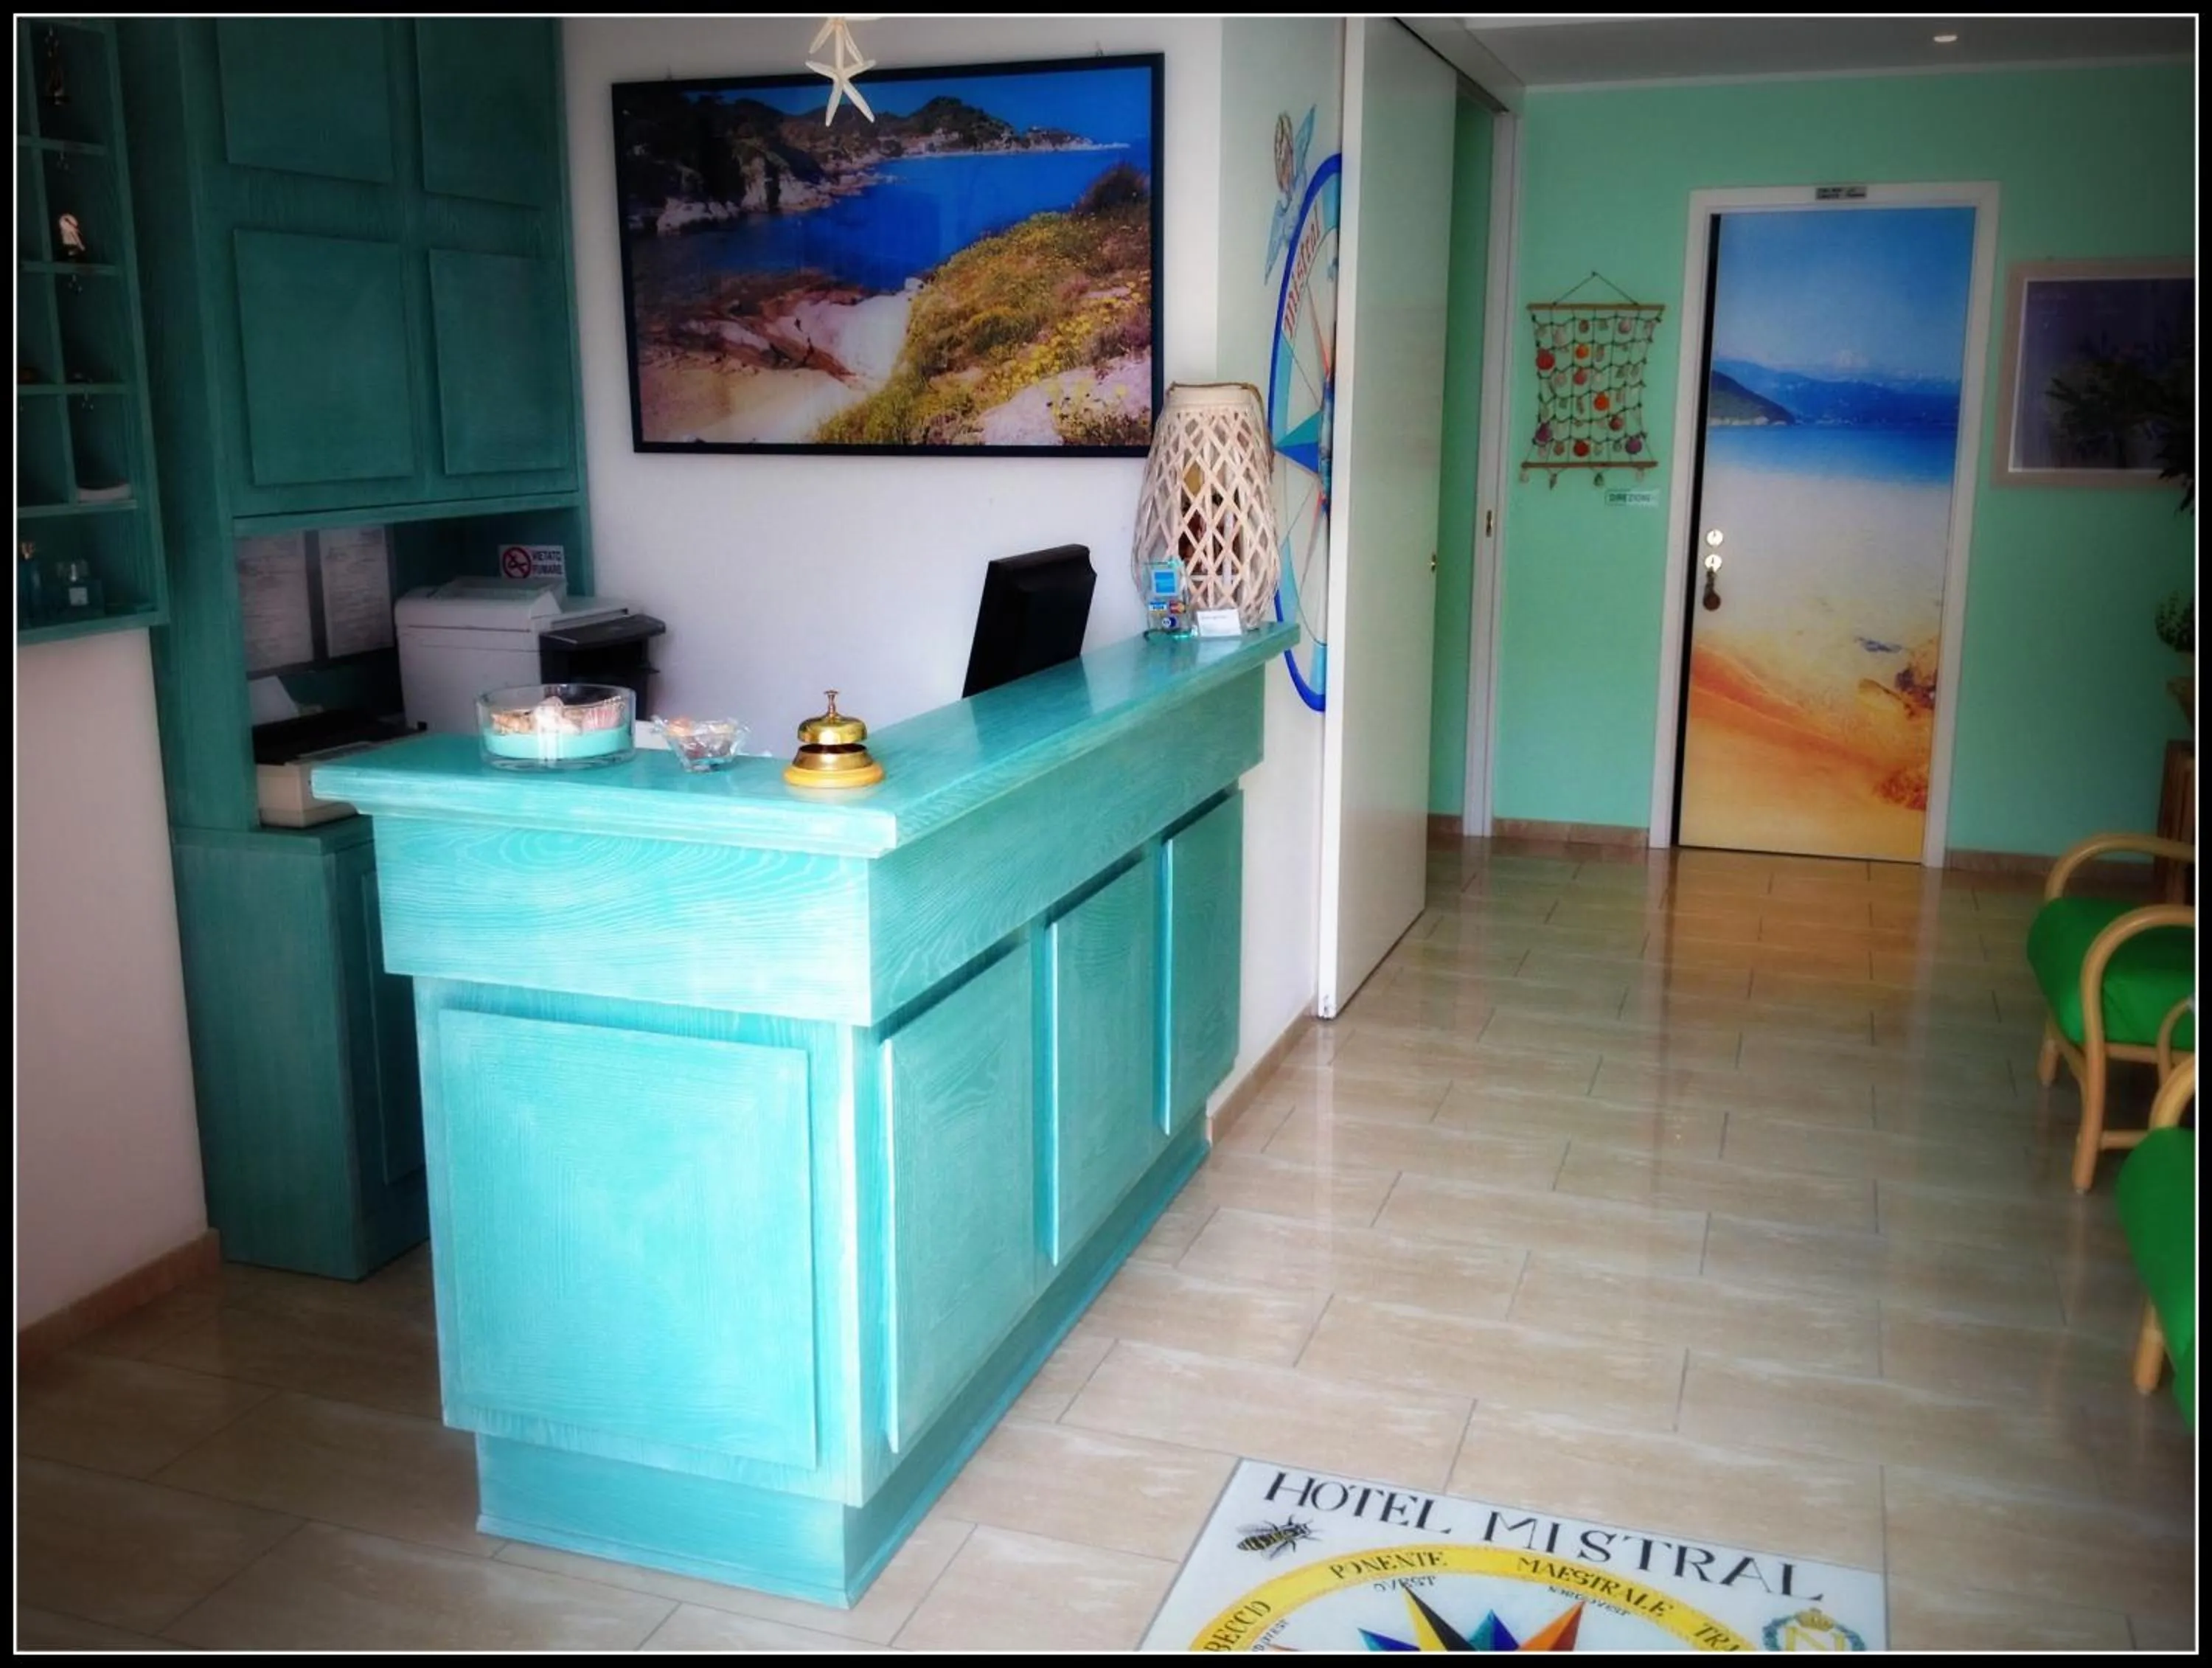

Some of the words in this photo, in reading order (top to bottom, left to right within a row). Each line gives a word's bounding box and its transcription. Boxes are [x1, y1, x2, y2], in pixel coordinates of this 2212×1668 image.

[532, 550, 561, 560] VIETATO
[532, 564, 563, 574] FUMARE
[1264, 1471, 1451, 1535] HOTEL
[1482, 1510, 1824, 1602] MISTRAL
[1329, 1551, 1447, 1580] PONENTE
[1517, 1557, 1674, 1617] MAESTRALE
